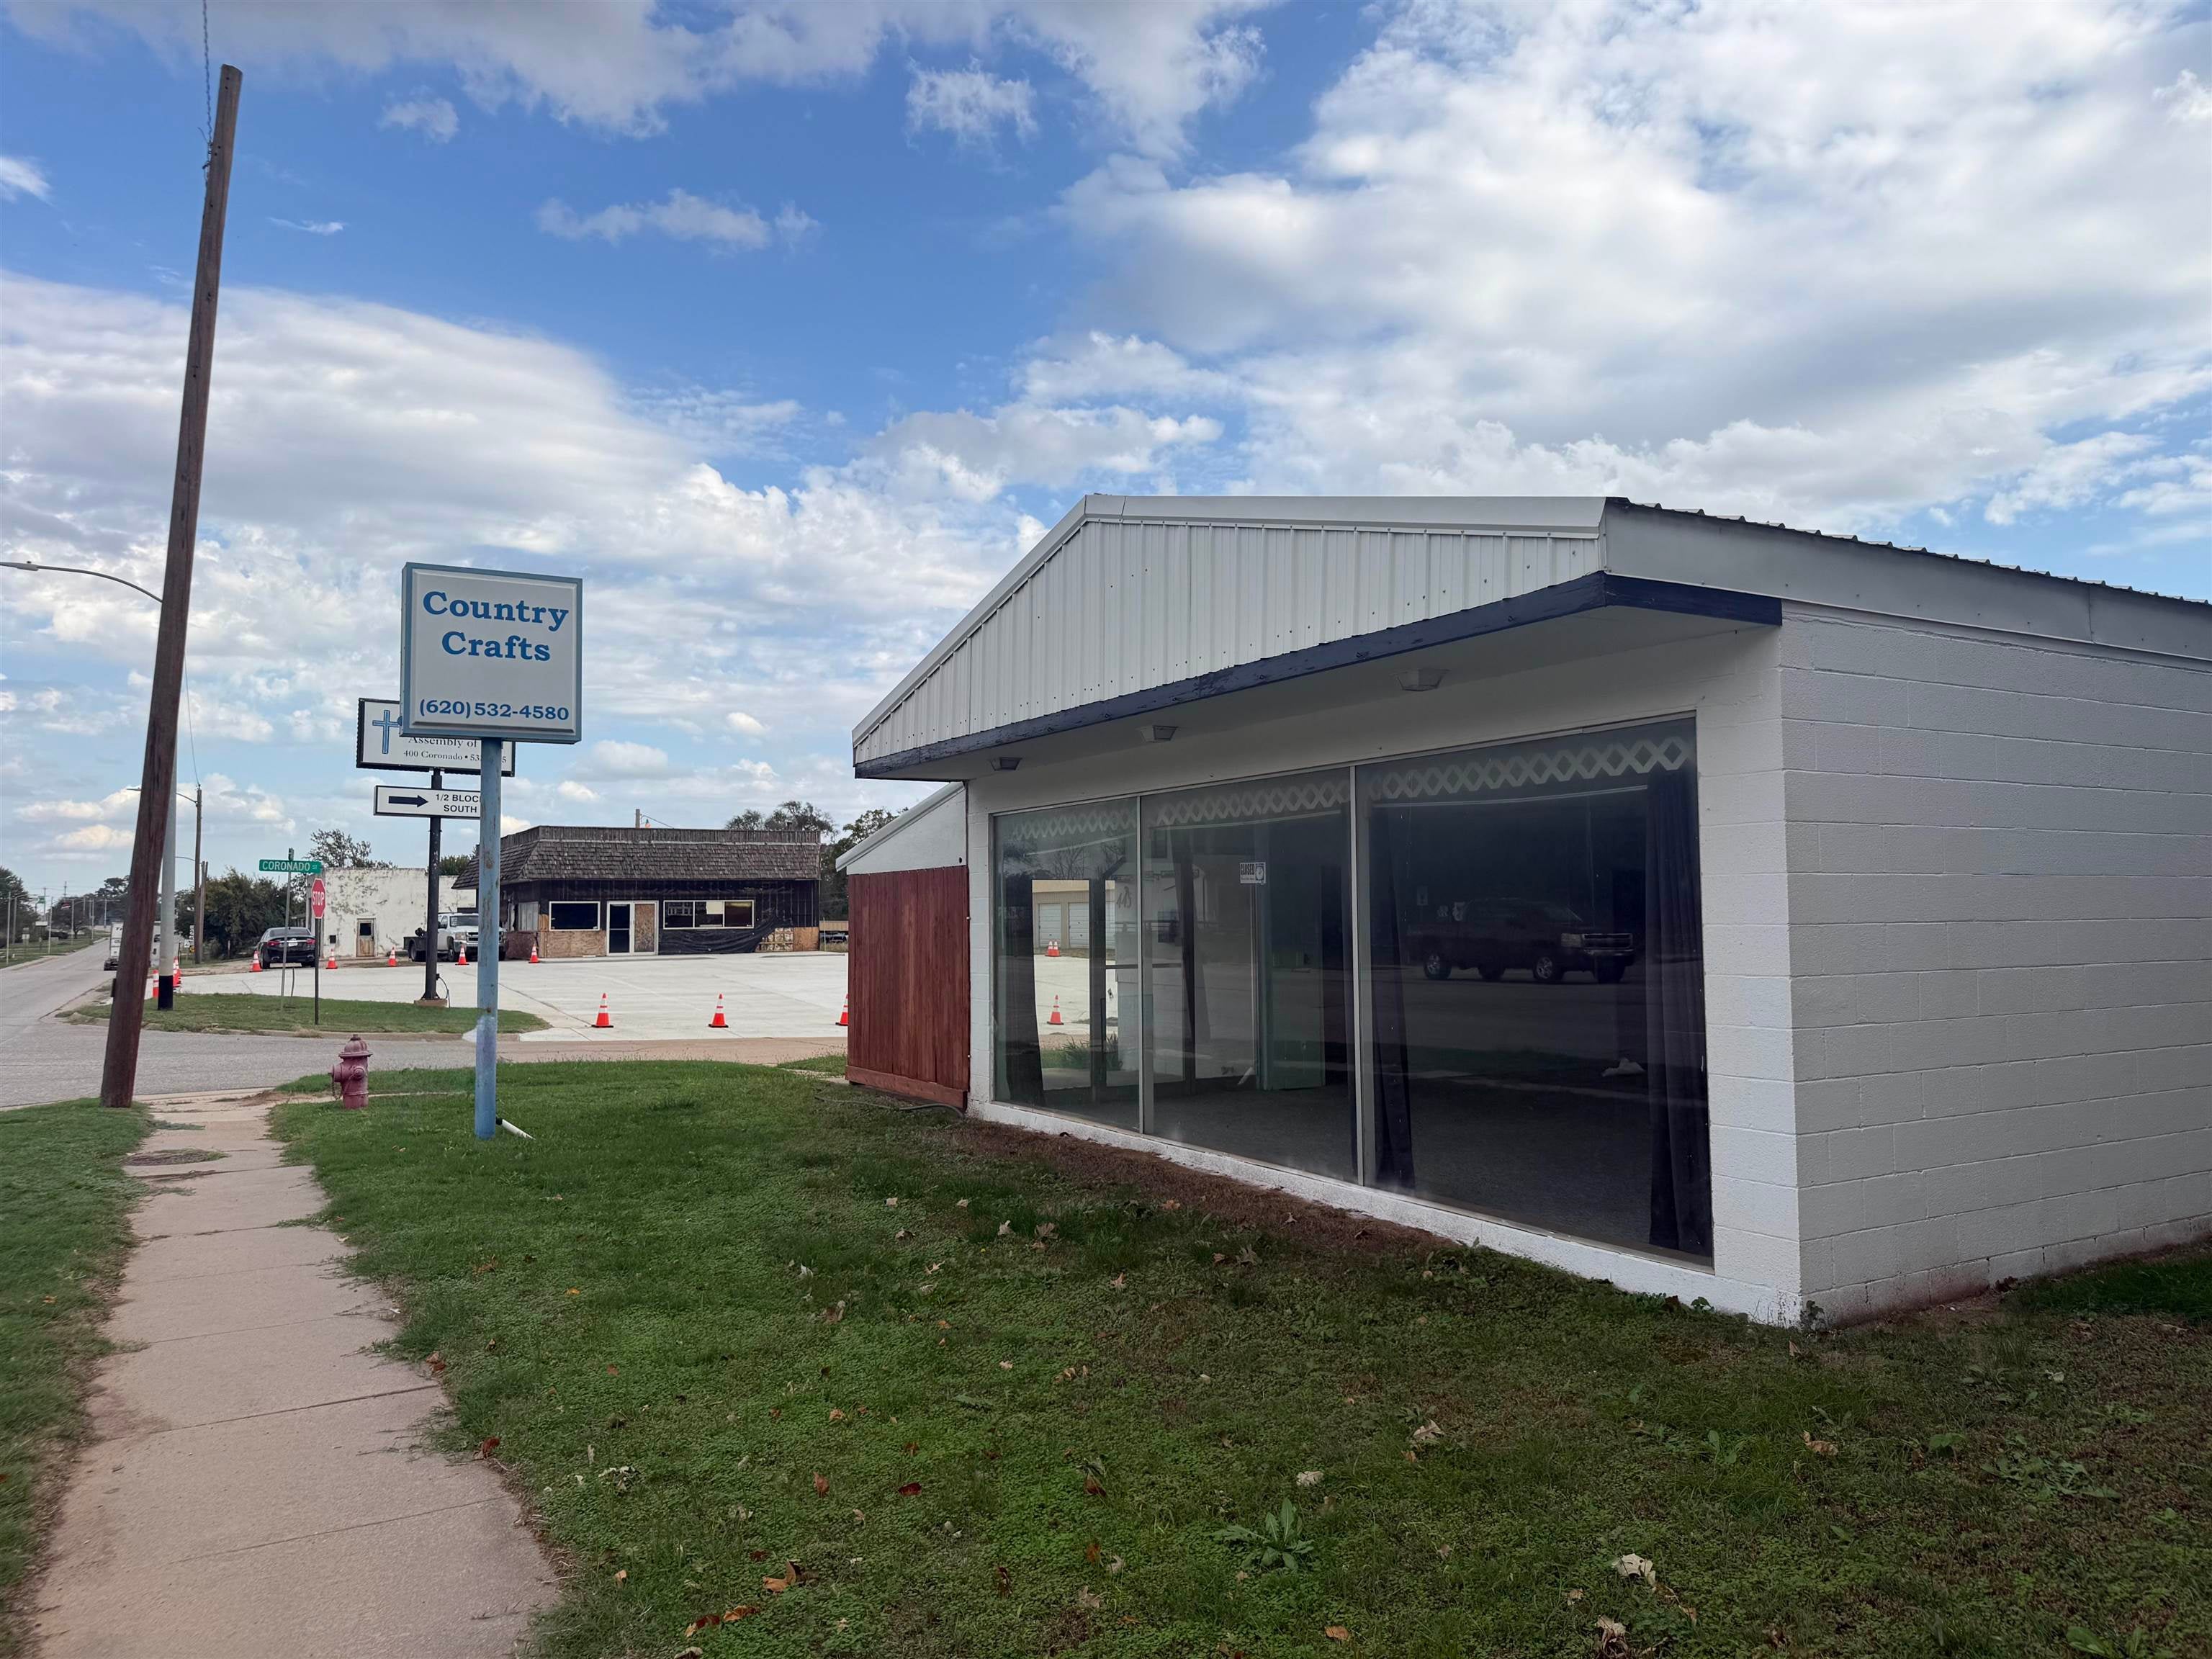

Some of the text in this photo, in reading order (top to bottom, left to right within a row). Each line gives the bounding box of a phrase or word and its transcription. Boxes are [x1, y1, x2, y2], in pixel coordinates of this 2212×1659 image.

[423, 591, 569, 631] Country
[441, 631, 550, 661] Crafts
[408, 737, 463, 748] Assembly
[421, 750, 463, 760] Coronado
[452, 794, 481, 803] BLOC
[444, 804, 477, 813] SOUTH
[262, 861, 310, 871] CORONADO
[313, 891, 325, 906] STOP
